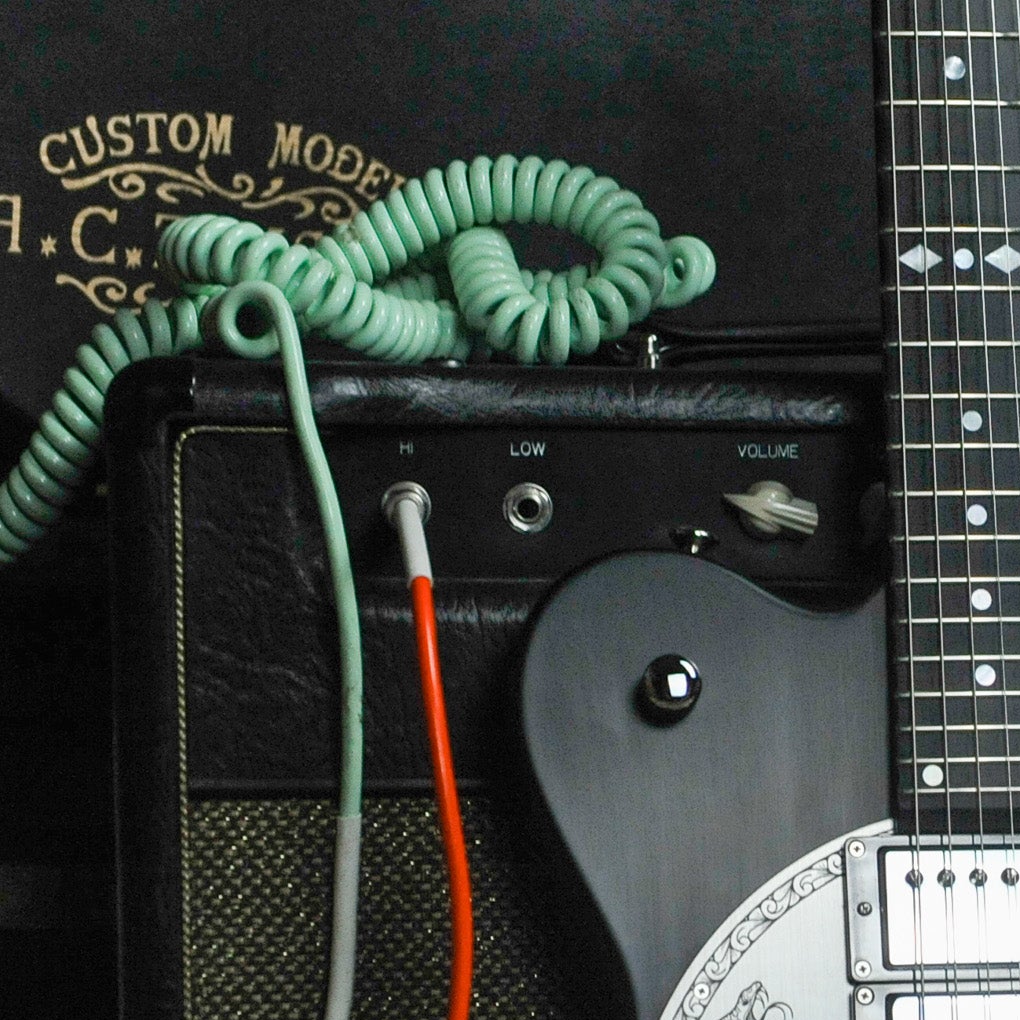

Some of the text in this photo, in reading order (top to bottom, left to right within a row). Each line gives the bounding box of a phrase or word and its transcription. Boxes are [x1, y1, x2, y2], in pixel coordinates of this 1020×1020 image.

[39, 112, 234, 174] CUSTOM
[399, 442, 414, 455] HI
[510, 442, 546, 457] LOW
[737, 443, 799, 460] VOLUME
